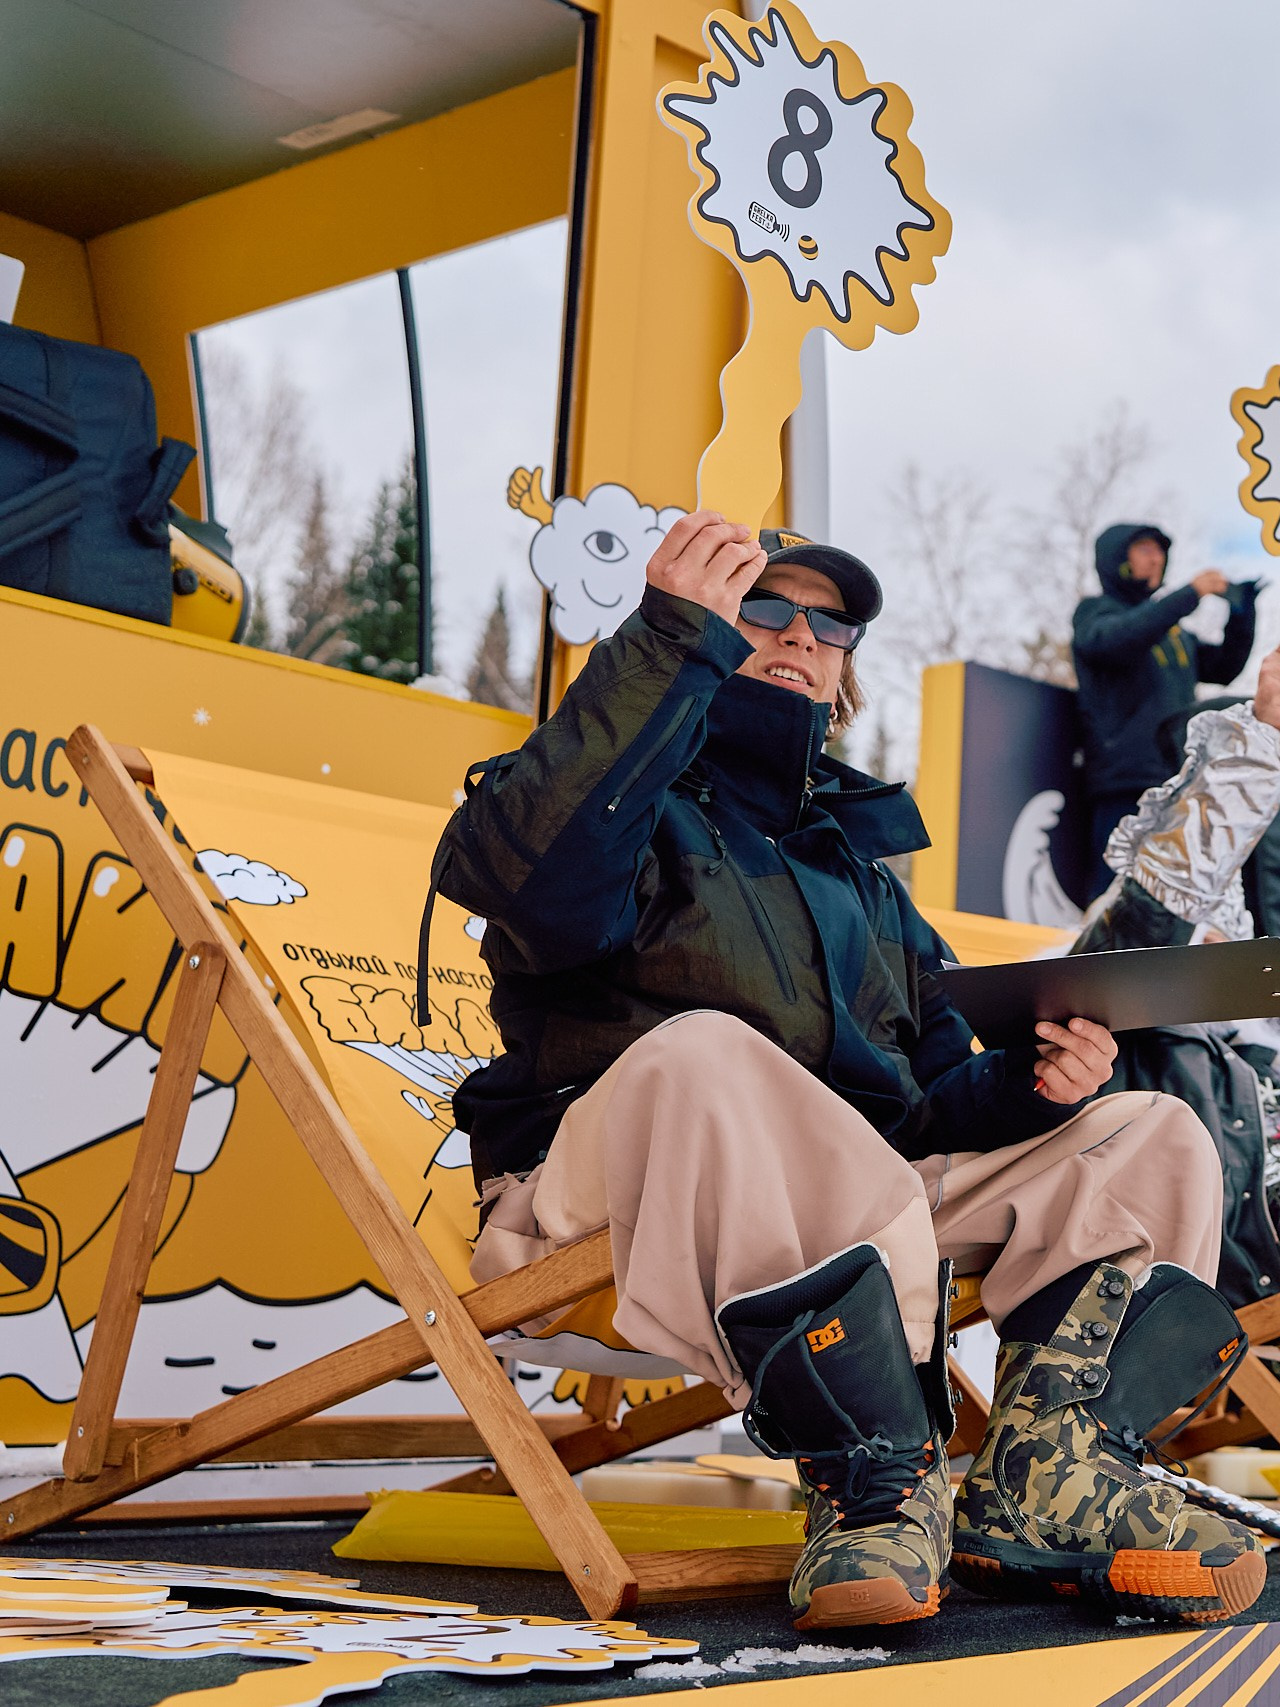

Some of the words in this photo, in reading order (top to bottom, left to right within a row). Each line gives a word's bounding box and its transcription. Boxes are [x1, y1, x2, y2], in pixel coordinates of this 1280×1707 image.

[767, 88, 833, 209] 8
[282, 942, 391, 976] отдыхай
[394, 960, 496, 991] по-насто
[806, 1317, 846, 1354] DC
[384, 1624, 512, 1645] 2
